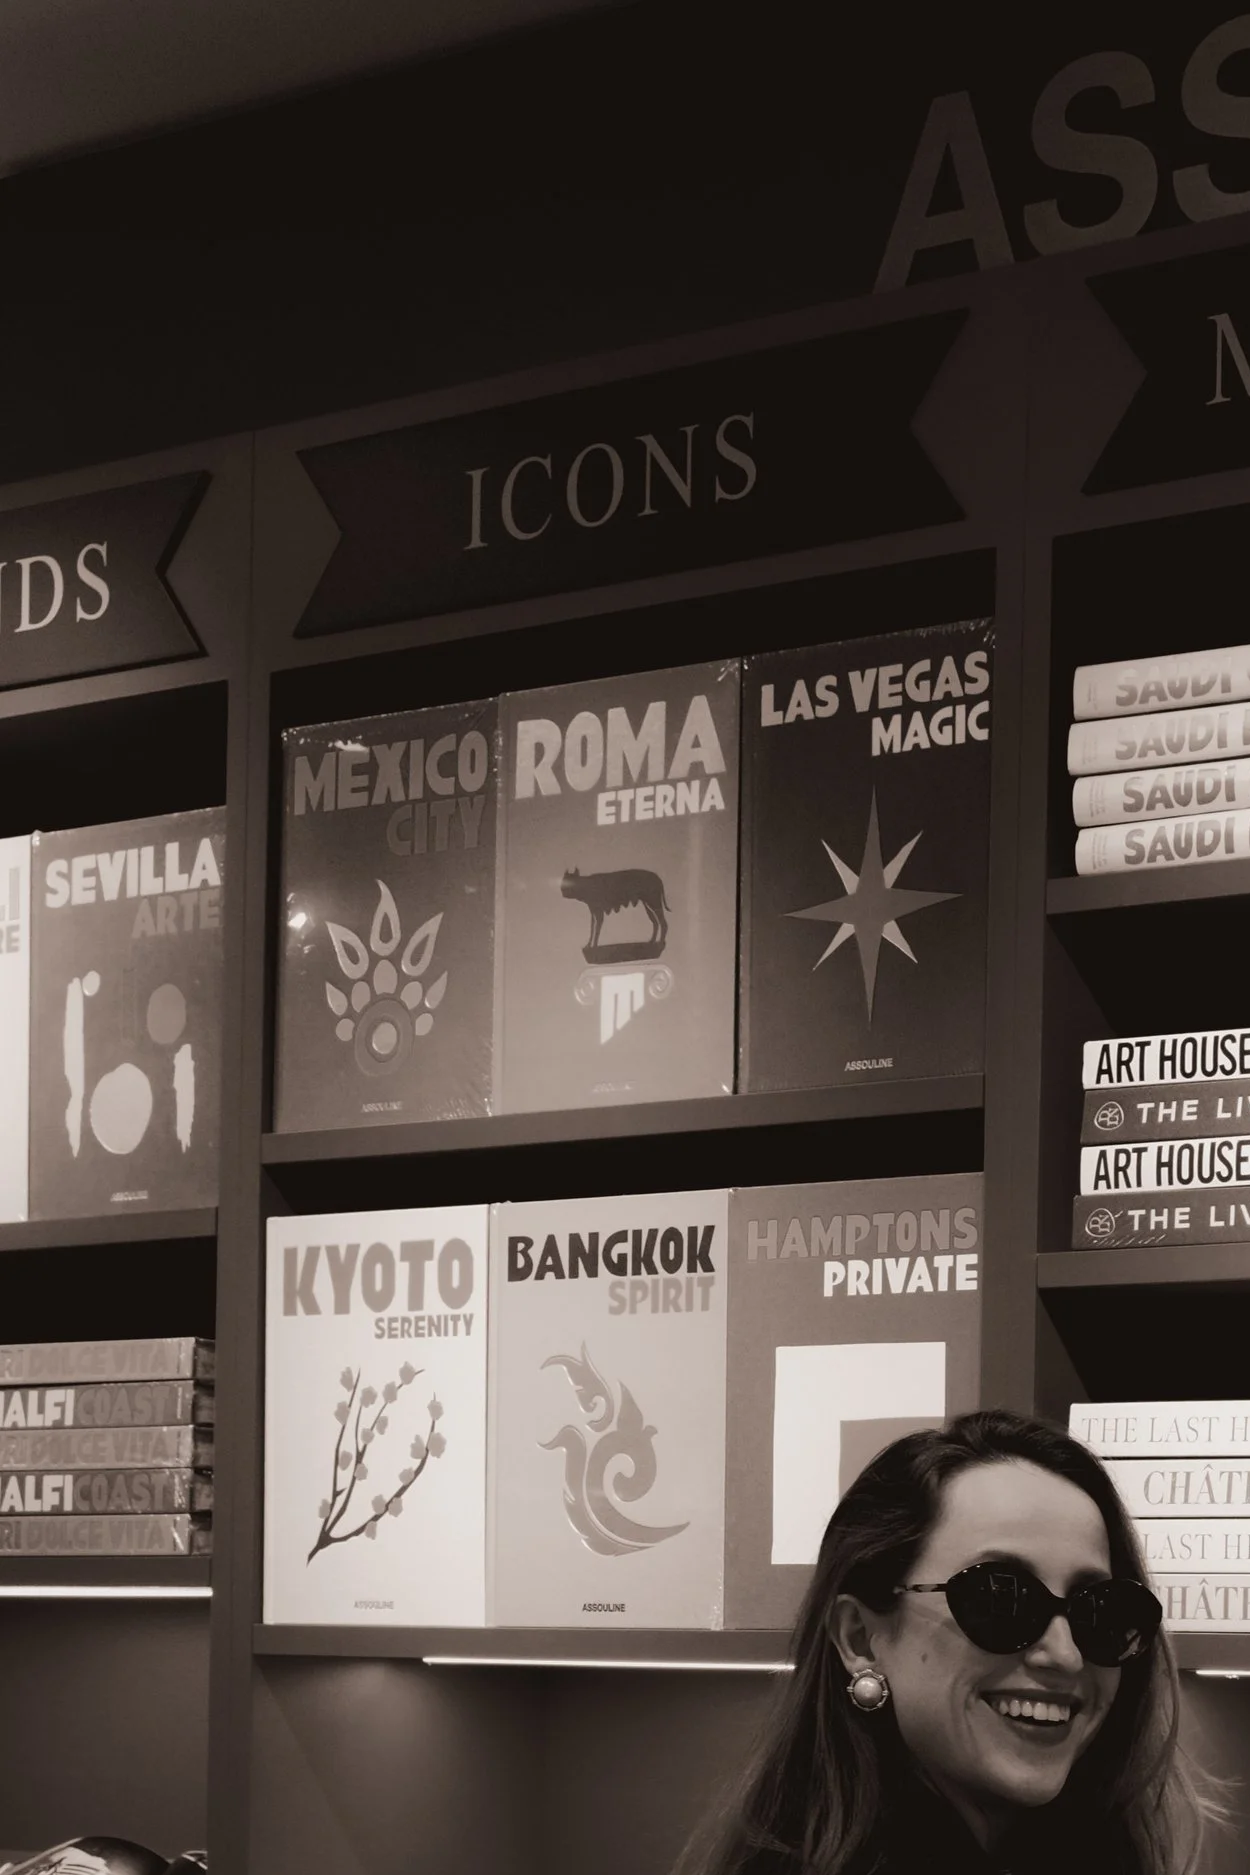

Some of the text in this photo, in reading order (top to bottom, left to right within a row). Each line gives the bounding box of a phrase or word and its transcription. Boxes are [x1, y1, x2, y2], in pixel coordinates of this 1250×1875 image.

[462, 412, 759, 551] ICONS
[0, 541, 112, 633] DS
[760, 650, 991, 728] LAS VEGAS
[514, 693, 728, 801] ROMA
[870, 700, 990, 757] MAGIC
[1114, 711, 1229, 762] SAUDI
[293, 729, 489, 817] MEXICO
[385, 793, 487, 857] CITY
[596, 777, 726, 826] ETERNA
[1122, 815, 1236, 866] SAUDI
[45, 838, 221, 909] SEVILLA
[131, 889, 220, 939] ARTE
[1095, 1040, 1152, 1085] ART
[1136, 1099, 1200, 1124] THE
[1093, 1147, 1149, 1190] ART
[746, 1206, 978, 1262] HAMPTONS
[1127, 1206, 1192, 1231] THE
[281, 1237, 474, 1317] KYOTO
[506, 1224, 716, 1283] BANGKOK
[822, 1253, 978, 1298] PRIVATE
[607, 1274, 715, 1317] SPIRIT
[374, 1312, 474, 1340] SERENITY
[0, 1386, 170, 1428] ALFI COAST
[1081, 1417, 1138, 1444] THE
[1148, 1416, 1220, 1444] LAST
[1141, 1533, 1213, 1561] LAST
[581, 1601, 626, 1614] ASSOULINE
